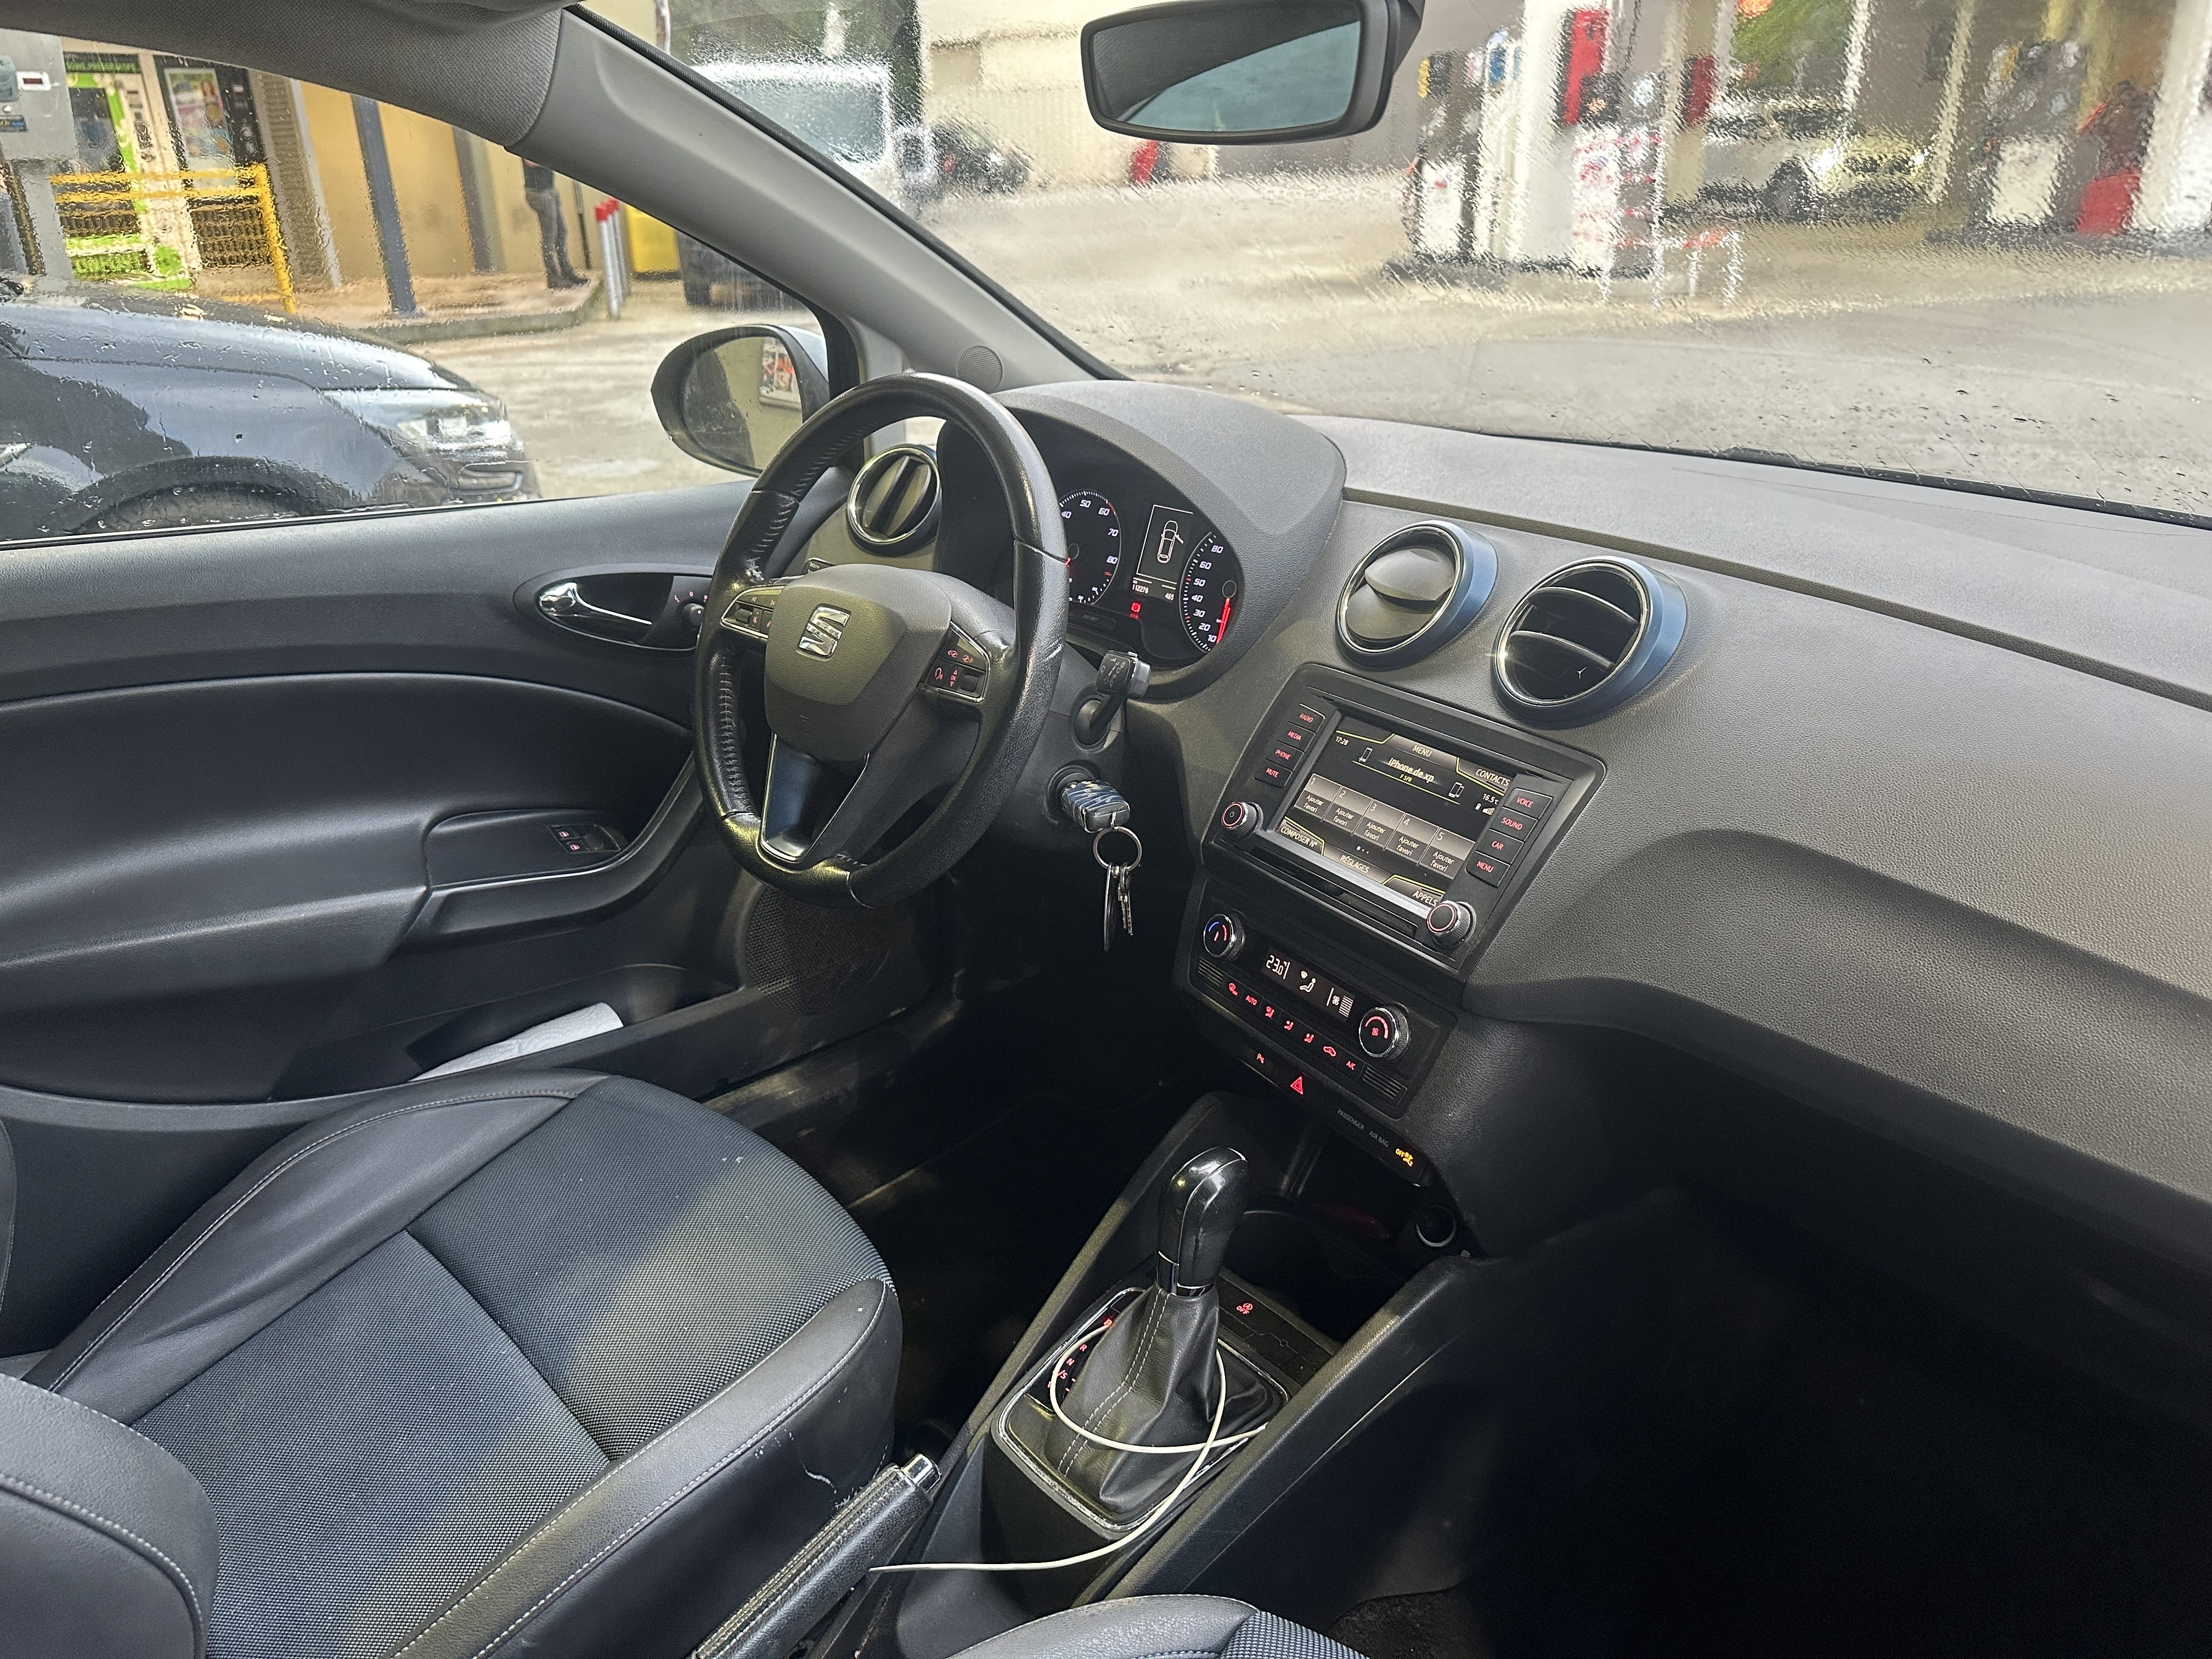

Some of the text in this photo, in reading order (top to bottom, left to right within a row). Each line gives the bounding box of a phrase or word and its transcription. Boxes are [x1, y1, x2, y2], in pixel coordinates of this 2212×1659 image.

[1080, 499, 1091, 508] 50
[1062, 511, 1072, 519] 40
[1098, 507, 1110, 516] 60
[1108, 528, 1119, 537] 70
[1211, 545, 1224, 554] 80
[1107, 556, 1118, 565] 80
[1199, 561, 1212, 570] 60
[1193, 578, 1206, 587] 50
[1192, 594, 1204, 602] 40
[1193, 609, 1205, 618] 30
[1198, 623, 1211, 631] 20
[1207, 634, 1217, 642] 10
[1299, 713, 1314, 723] RADIO
[1288, 731, 1302, 741] MEDIA
[1275, 749, 1291, 760] PHONE
[1412, 745, 1432, 758] MENU
[1266, 768, 1280, 778] MUTE
[1476, 769, 1510, 787] CONTACTS
[1306, 795, 1324, 806] Ajouter
[1516, 797, 1534, 808] VOICE
[1304, 803, 1318, 813] favori
[1335, 808, 1355, 820] Ajouter
[1333, 816, 1348, 827] favori
[1501, 817, 1523, 830] SOUND
[1366, 822, 1386, 834] Ajouter
[1280, 826, 1312, 845] COMPOSER
[1364, 830, 1380, 841] favori
[1437, 832, 1444, 840] 5
[1398, 836, 1419, 849] Ajouter
[1492, 841, 1504, 850] CAR
[1396, 844, 1413, 856] favori
[1432, 851, 1454, 865] Ajouter
[1340, 855, 1370, 873] RÉGLAGES
[1430, 860, 1448, 872] favori
[1476, 861, 1494, 872] MENU
[1413, 890, 1438, 906] APPELS
[1245, 995, 1257, 1006] AUTO
[1346, 1060, 1356, 1070] A/C
[1337, 1108, 1365, 1131] PASSENGER
[1369, 1130, 1389, 1147] AIR BAG
